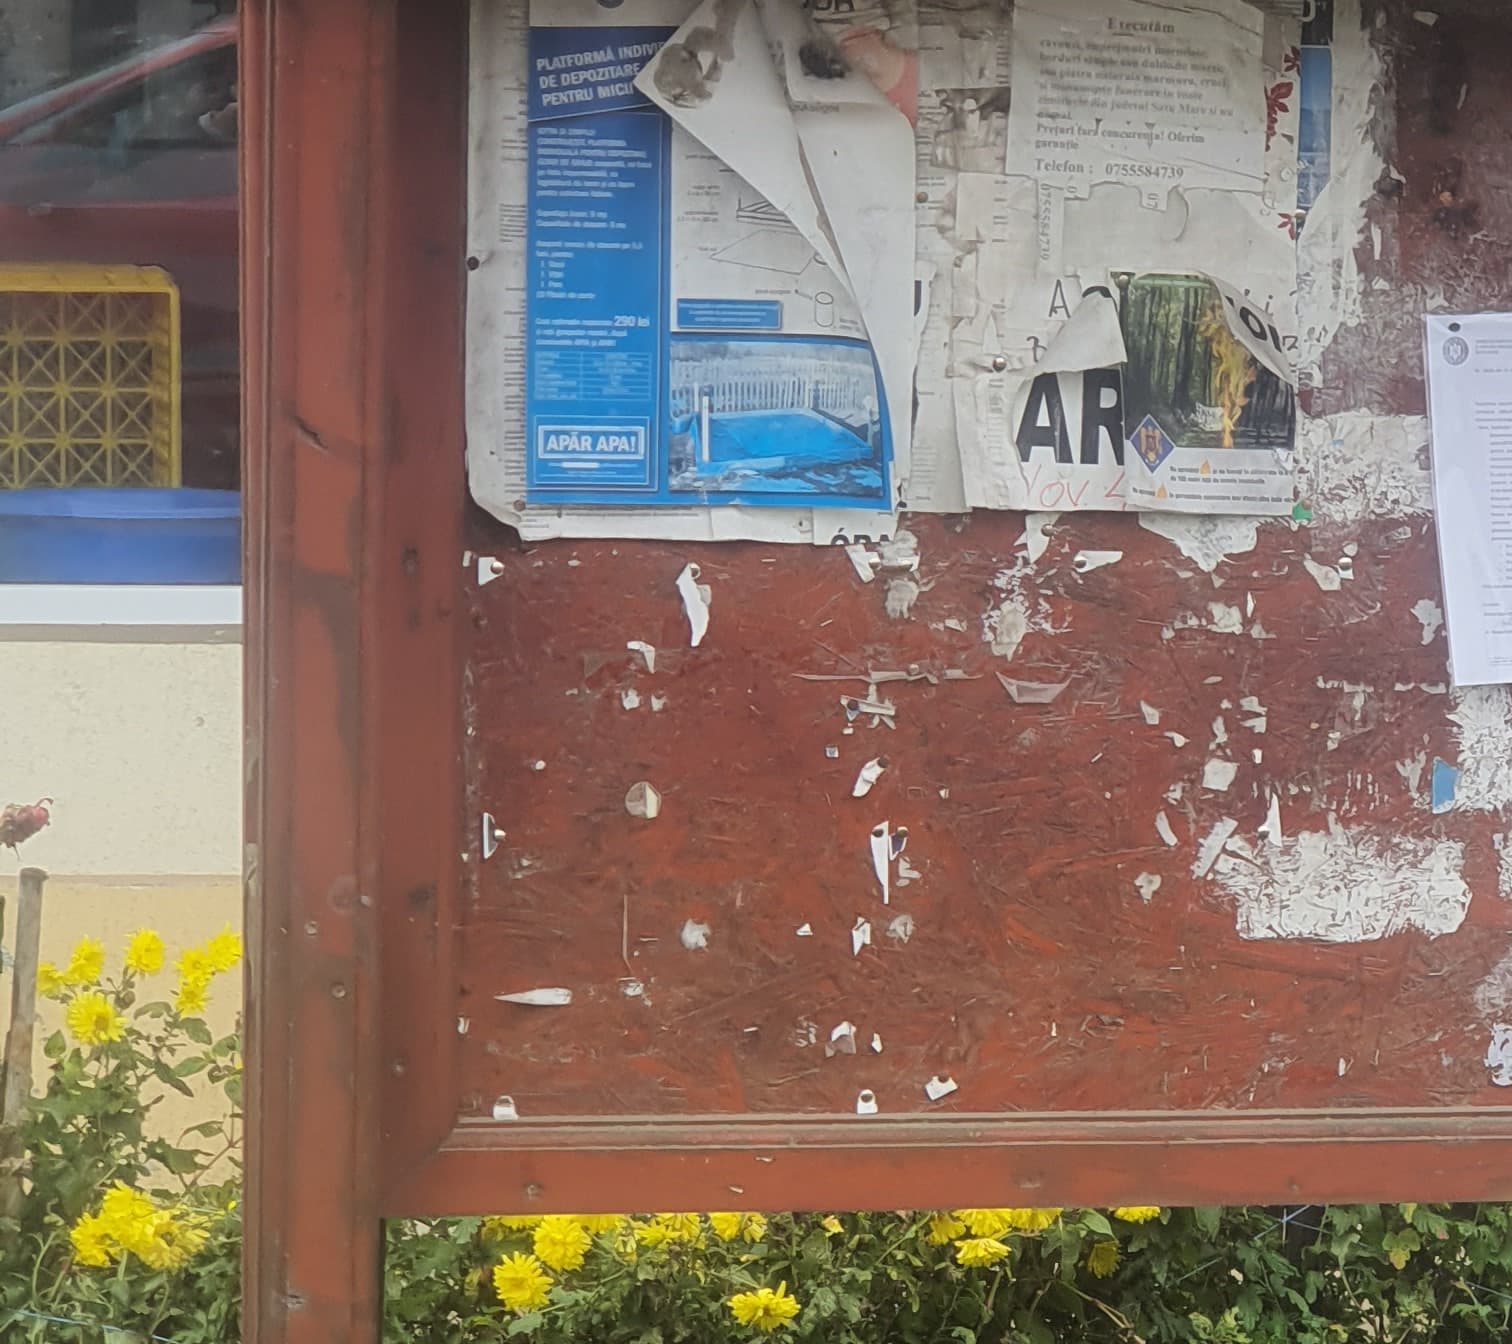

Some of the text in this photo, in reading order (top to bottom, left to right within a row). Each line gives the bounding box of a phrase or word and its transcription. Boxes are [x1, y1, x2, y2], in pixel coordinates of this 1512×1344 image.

[537, 46, 615, 71] PLATFORMĂ
[539, 62, 641, 89] DE DEPOZITARE
[542, 87, 593, 106] PENTRU
[1034, 158, 1085, 174] Telefon
[1105, 162, 1184, 179] 0755584739
[547, 432, 636, 453] APĂR APA!
